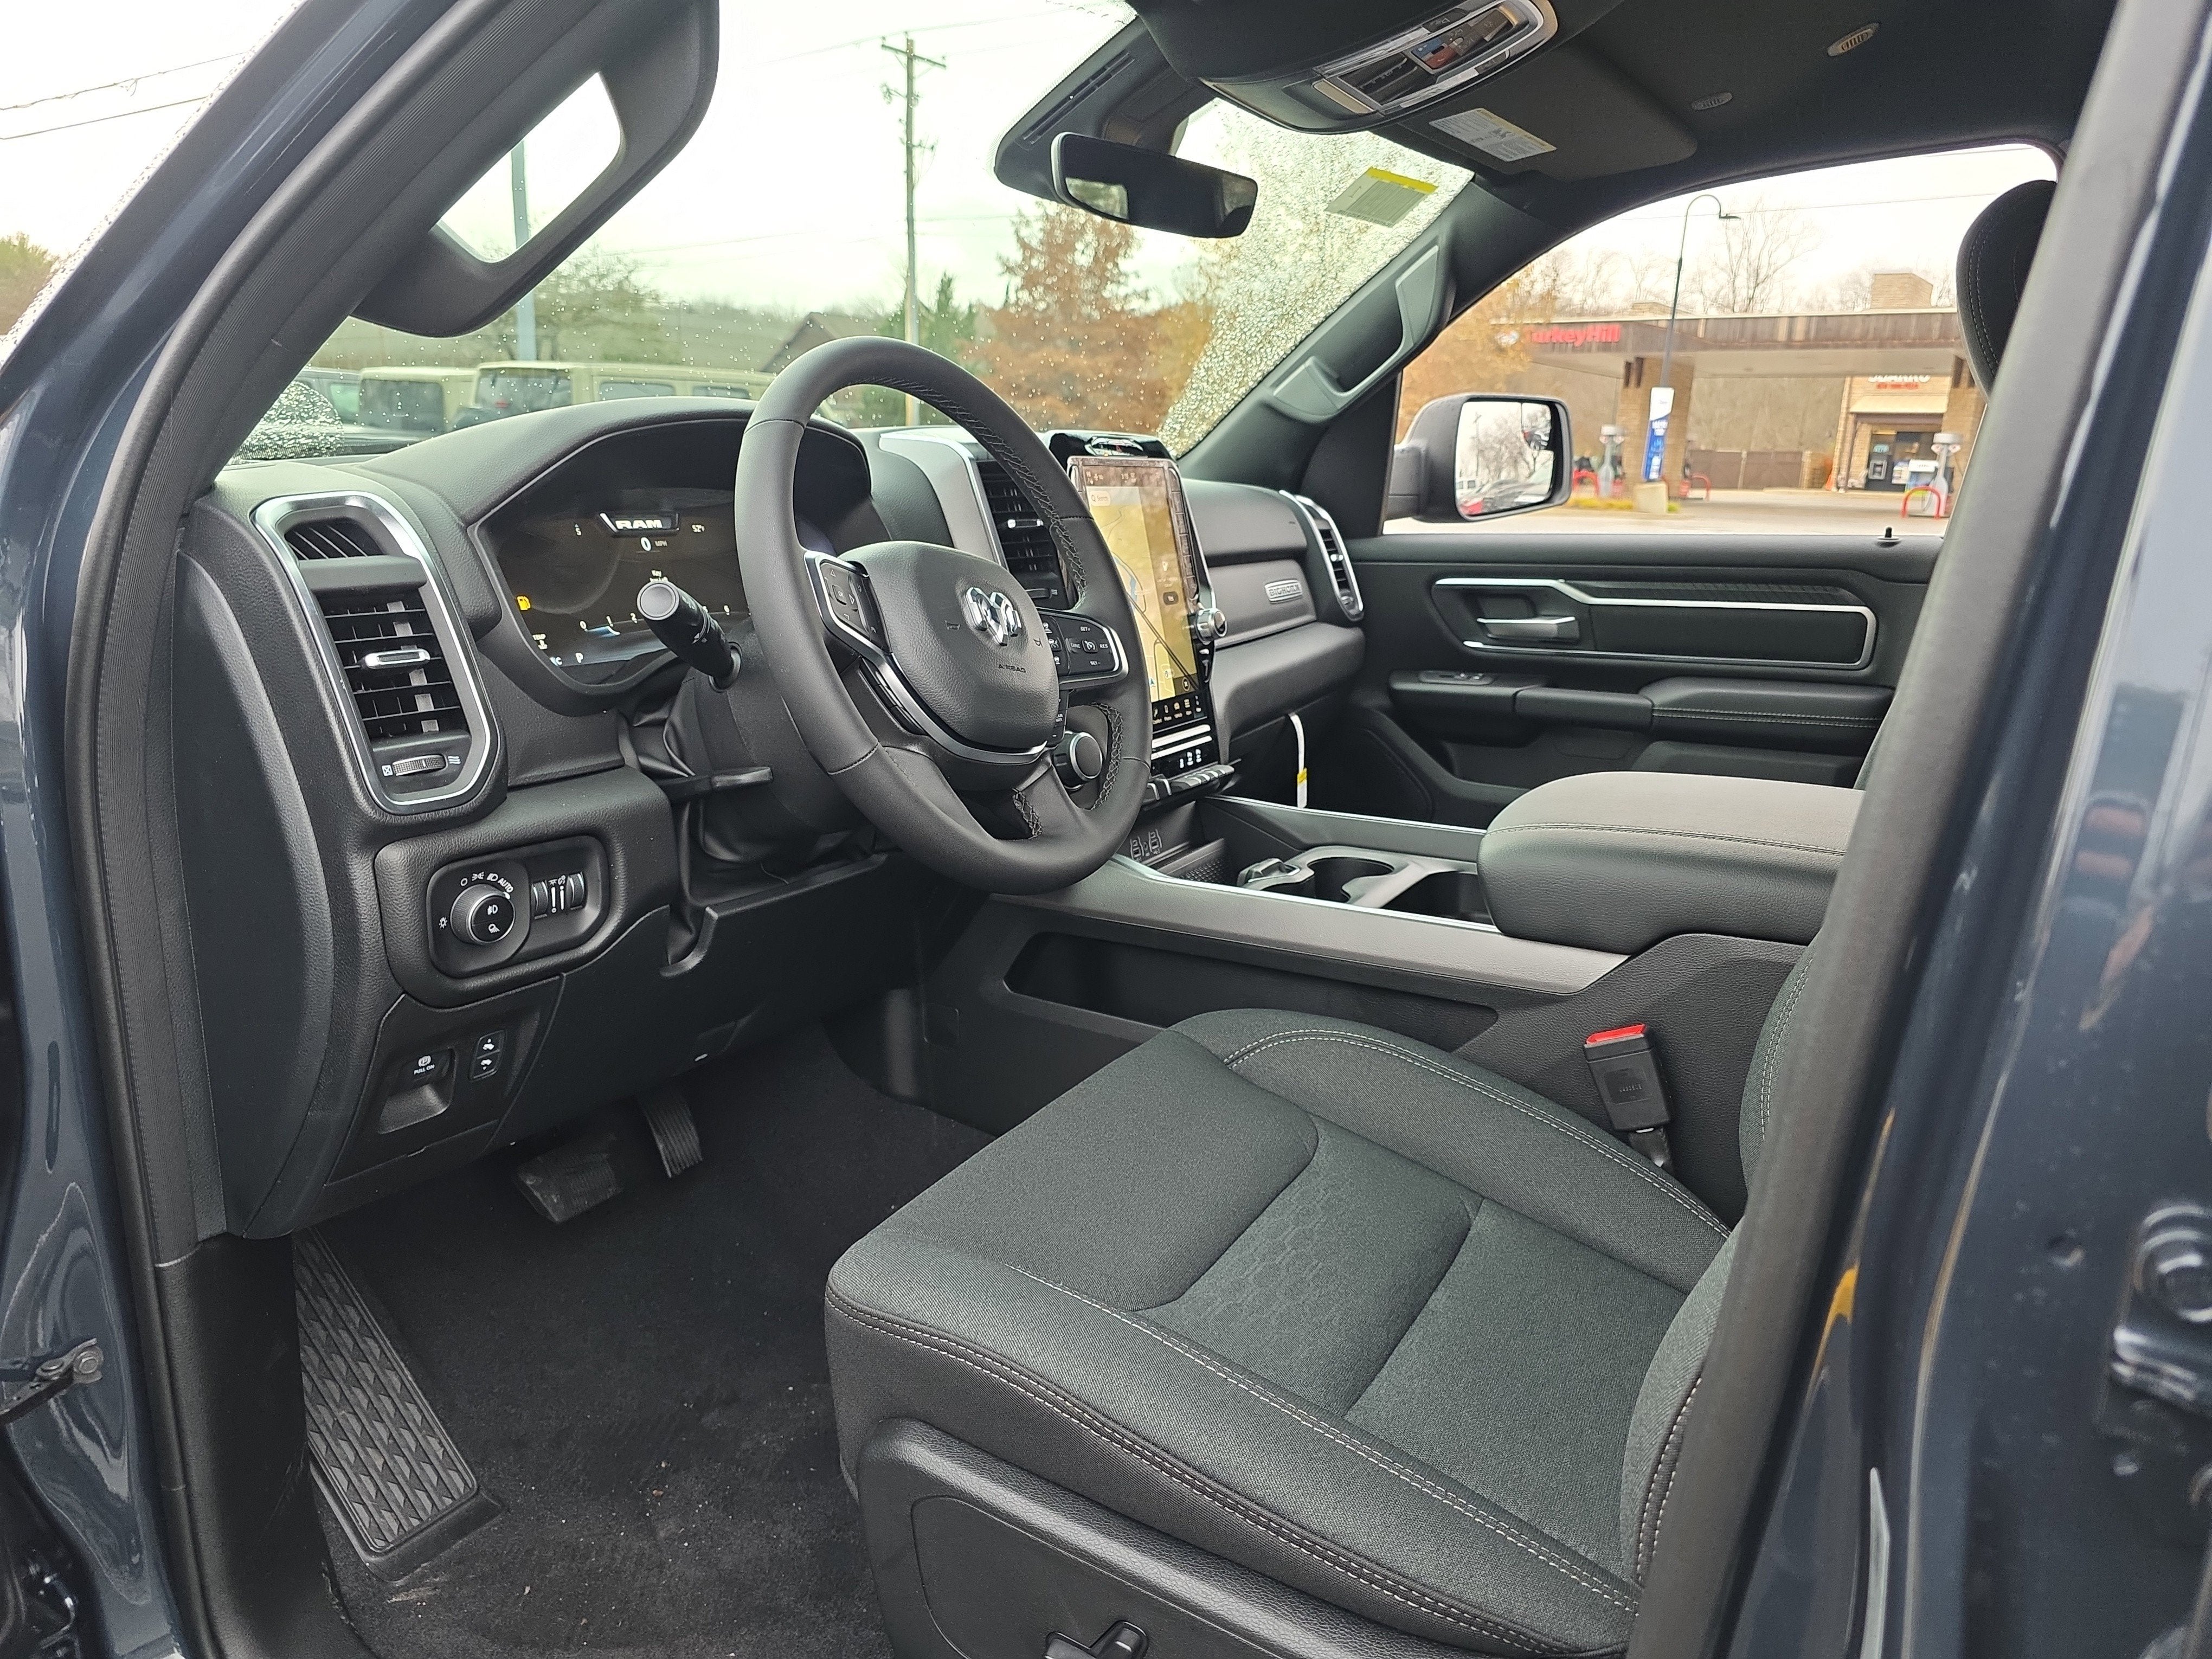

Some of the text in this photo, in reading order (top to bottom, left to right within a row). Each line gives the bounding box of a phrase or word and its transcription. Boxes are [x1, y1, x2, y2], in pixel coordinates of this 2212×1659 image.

[615, 519, 663, 530] RAM
[497, 878, 514, 893] AUTO
[414, 1067, 426, 1075] PULL
